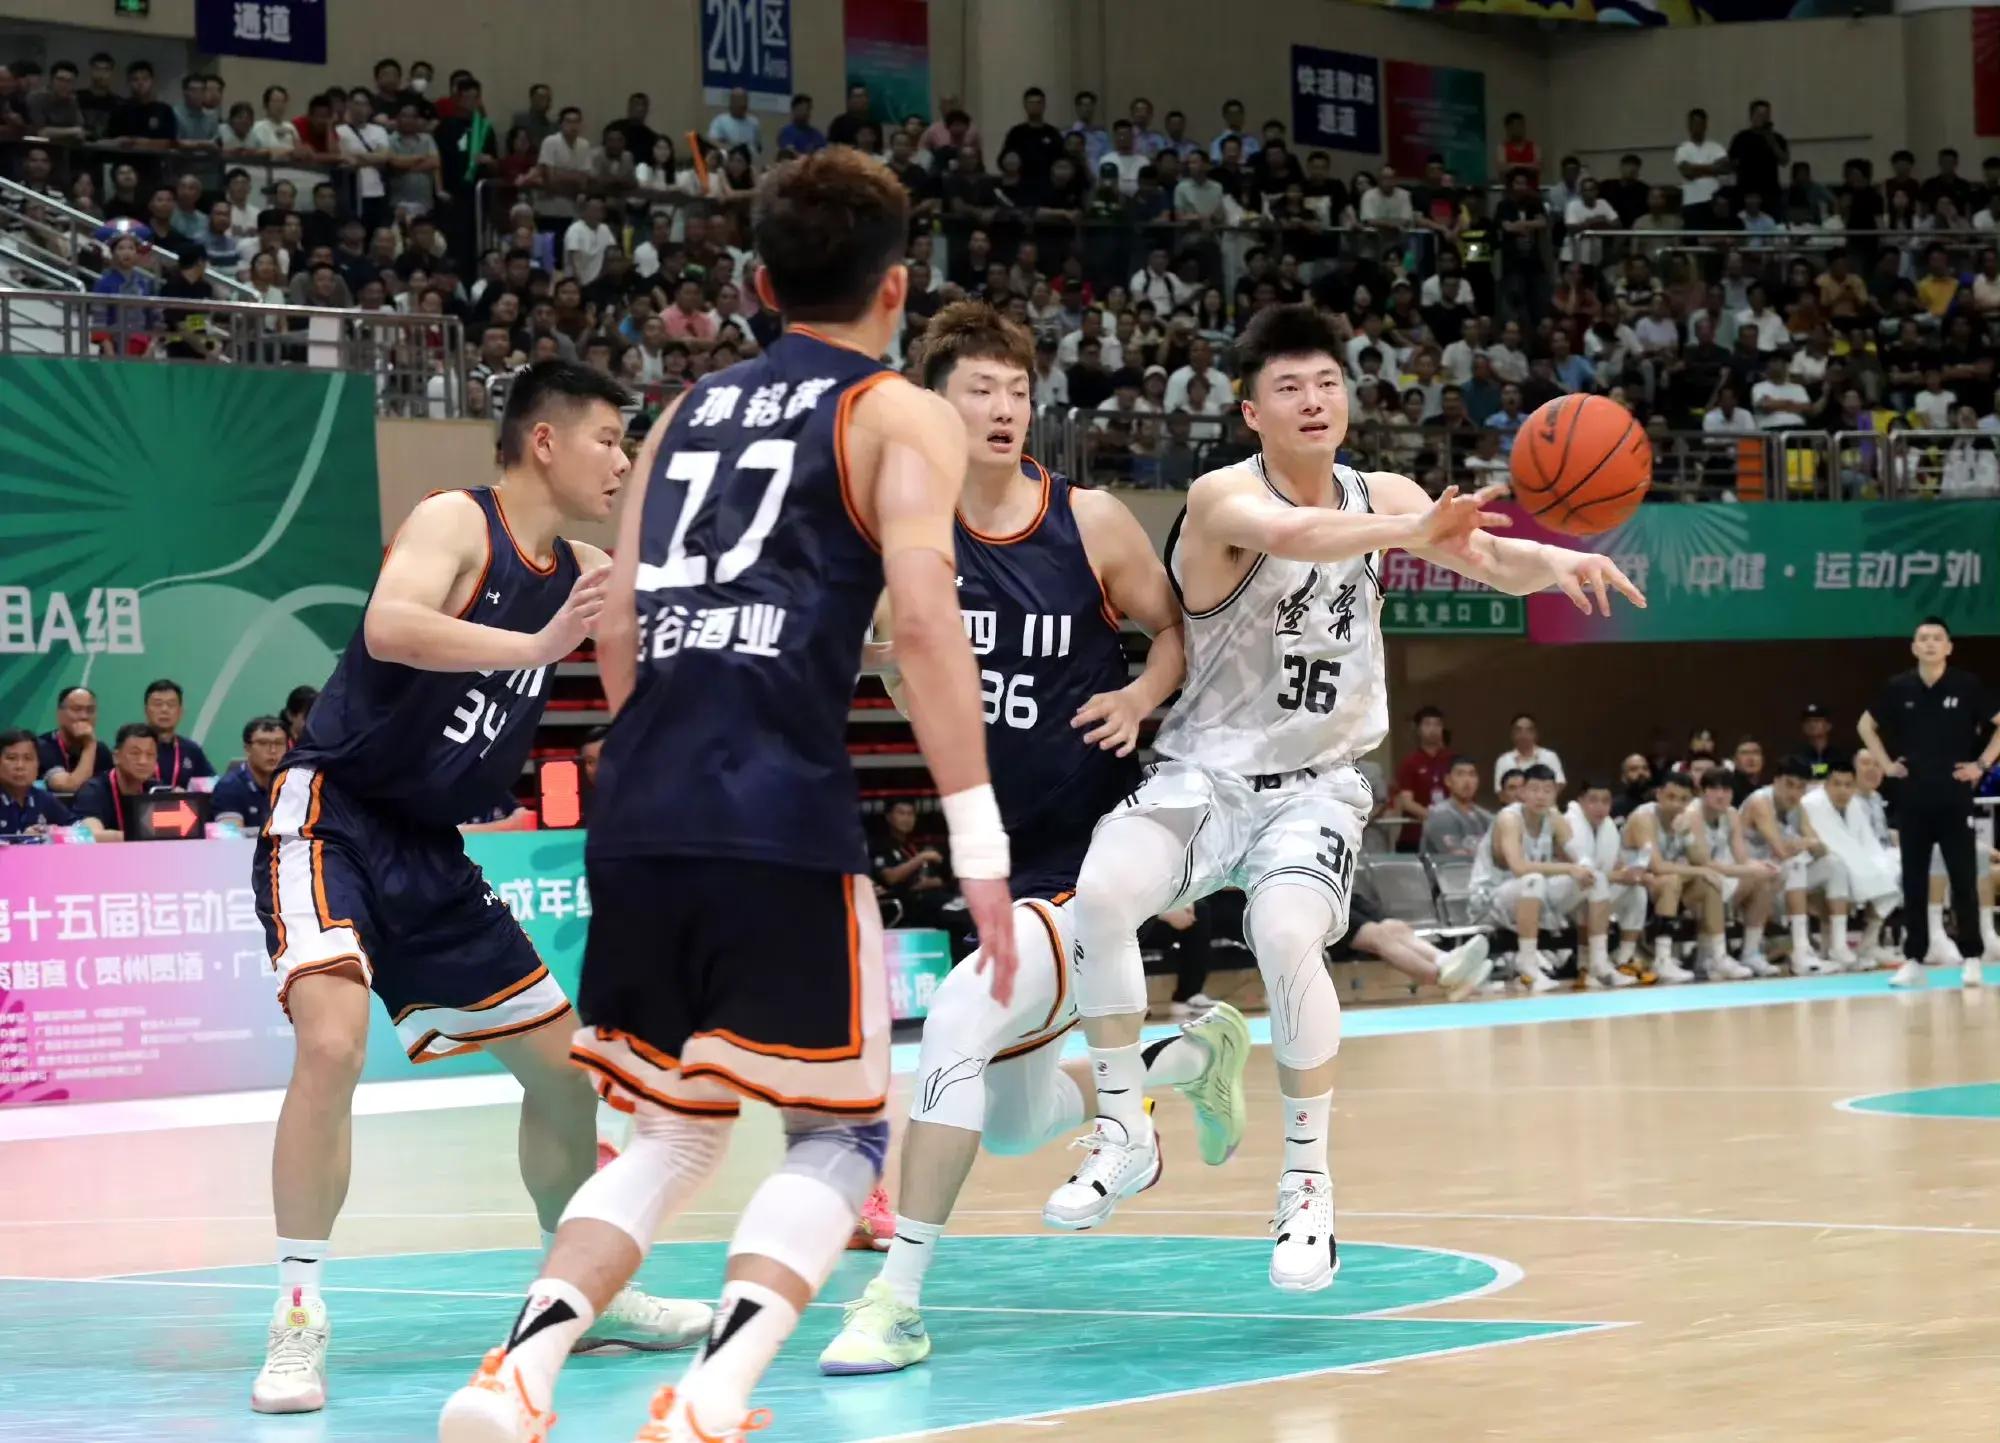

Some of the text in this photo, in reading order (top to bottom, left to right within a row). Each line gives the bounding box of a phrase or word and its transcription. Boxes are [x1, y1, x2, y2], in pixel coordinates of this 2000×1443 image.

[233, 2, 290, 42] 通道
[1317, 103, 1357, 137] 通道
[635, 439, 797, 592] 17
[960, 610, 1071, 658] 四川
[1490, 601, 1506, 625] D
[981, 669, 1038, 730] 36
[1277, 654, 1341, 714] 36
